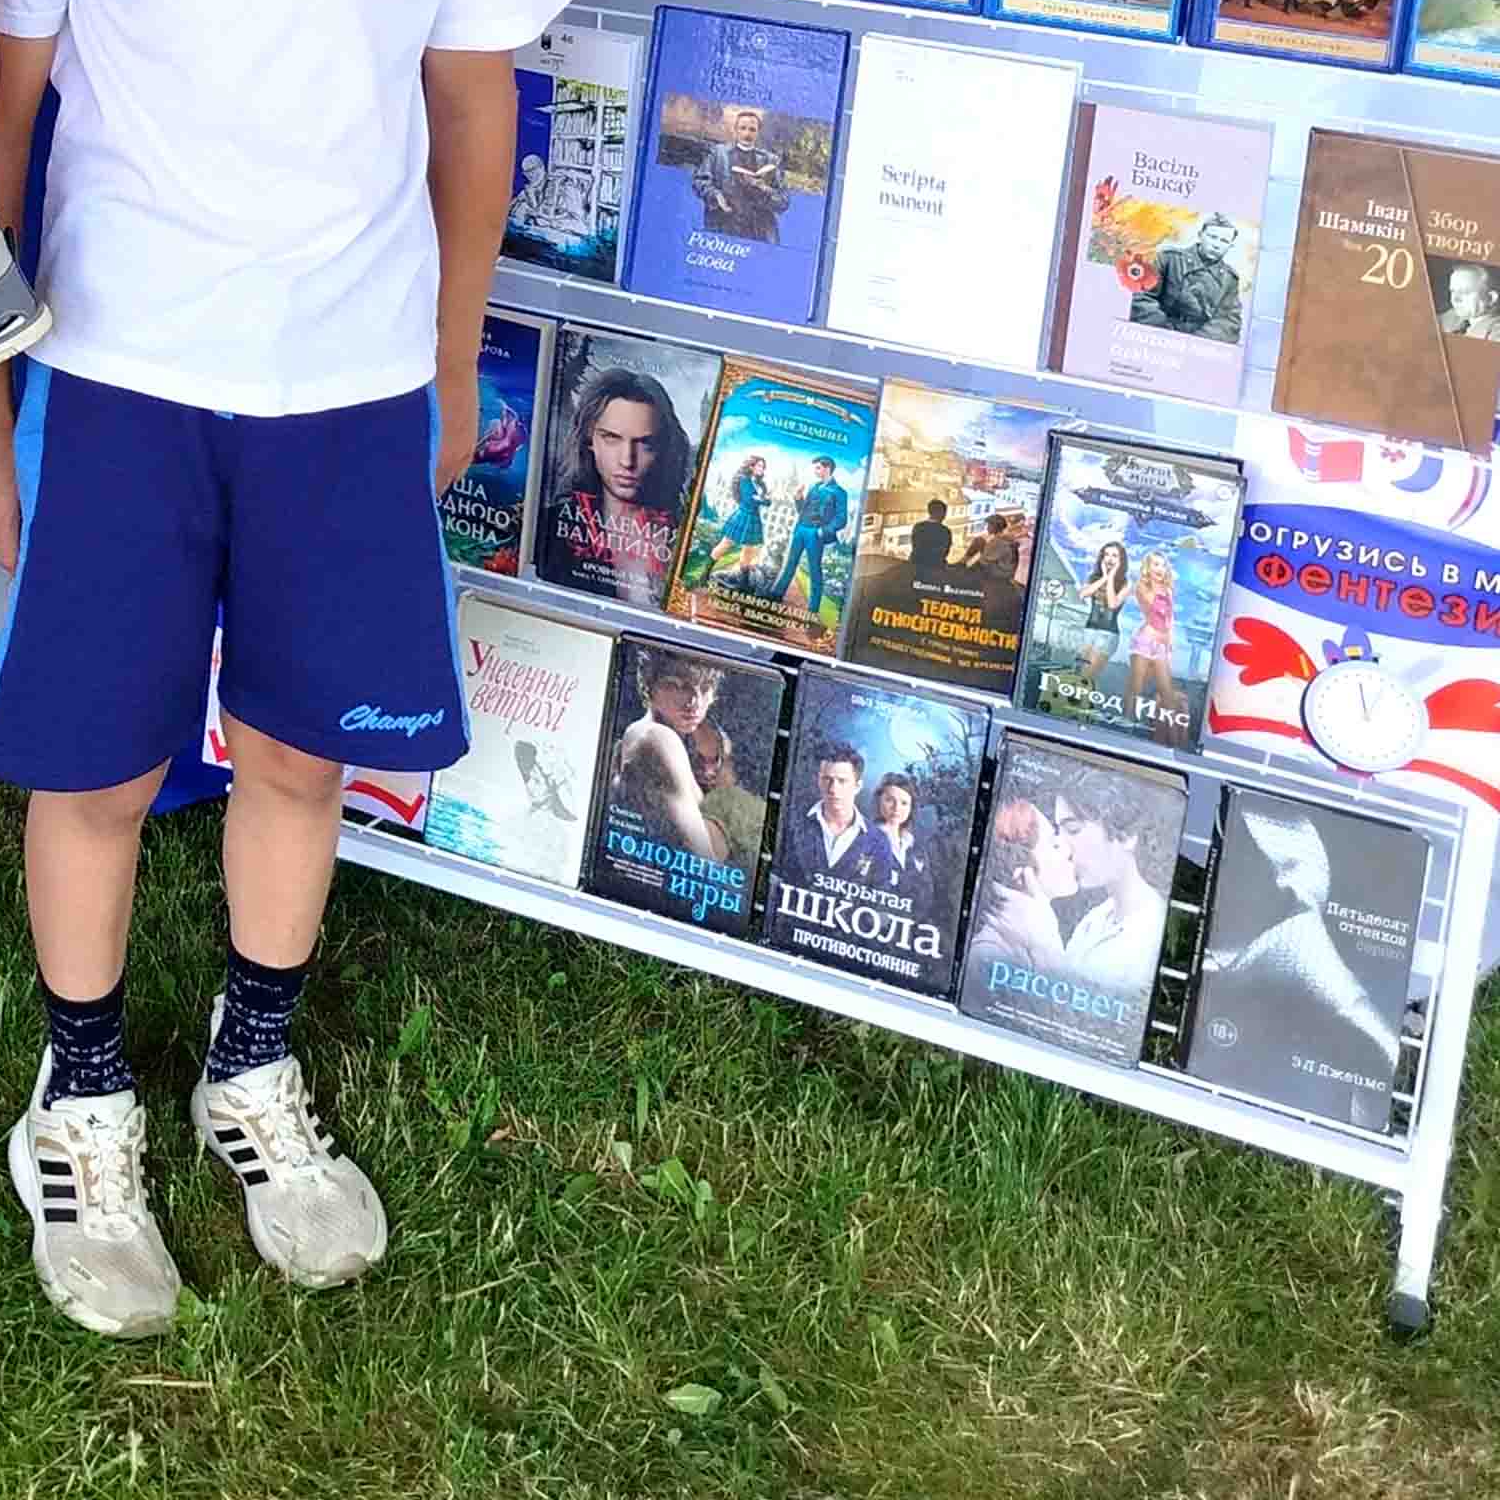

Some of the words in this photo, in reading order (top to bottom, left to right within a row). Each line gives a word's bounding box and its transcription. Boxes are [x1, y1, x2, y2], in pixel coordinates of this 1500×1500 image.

[881, 163, 948, 193] Scripta
[1133, 150, 1200, 179] Васіль
[1131, 169, 1197, 199] Быкаў
[1318, 210, 1405, 242] Шамякін
[1365, 199, 1410, 223] Іван
[1427, 209, 1479, 238] Збор
[1425, 233, 1495, 260] твораў
[1360, 243, 1415, 289] 20
[556, 520, 672, 562] ВАМПИРО
[1442, 563, 1461, 584] В
[919, 598, 982, 624] ТЕОРИЯ
[871, 606, 1019, 650] ОТНОСИТЕЛЬНОСТИ
[339, 703, 445, 739] Champs
[668, 874, 743, 921] игры
[812, 871, 914, 915] закрытая
[1326, 900, 1410, 934] Пятьдесят
[1338, 919, 1408, 948] оттенков
[792, 927, 921, 979] ПРОТИВОСТОЯНИЕ
[987, 960, 1128, 1023] рассвет
[1211, 1022, 1236, 1041] 18+
